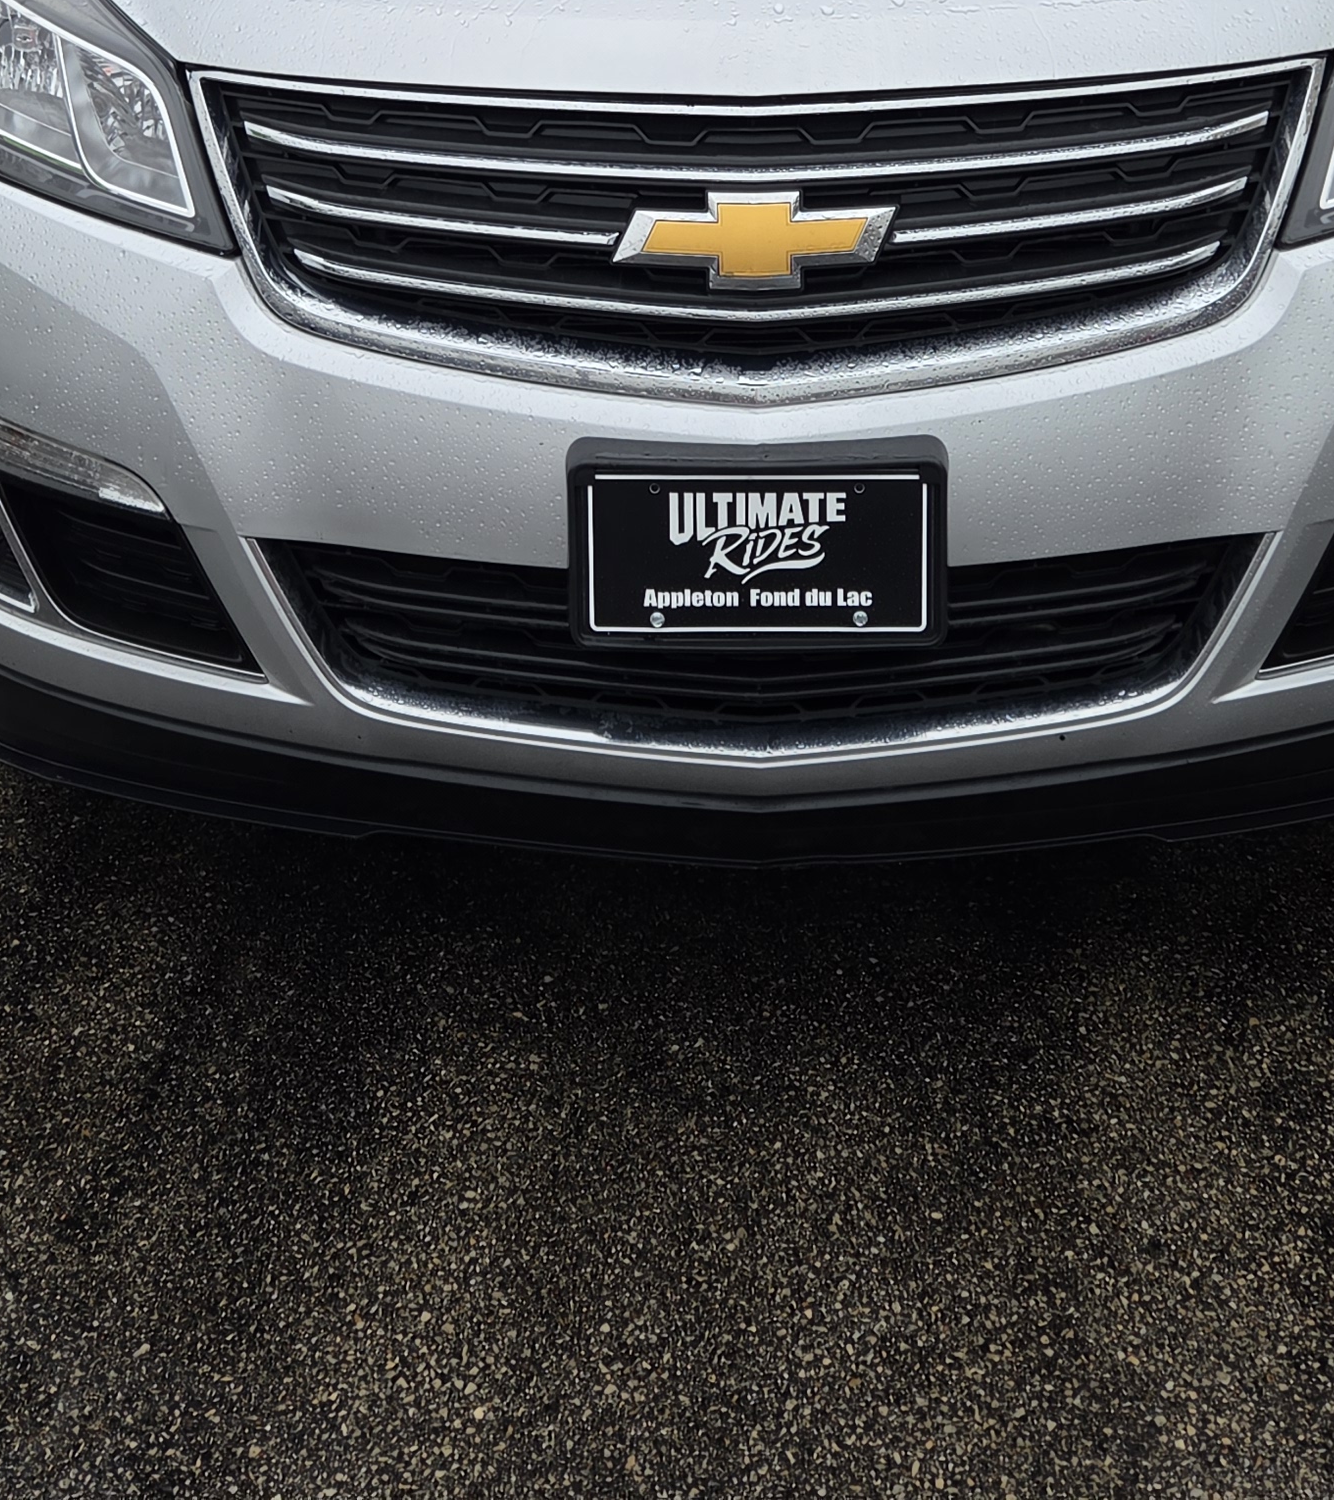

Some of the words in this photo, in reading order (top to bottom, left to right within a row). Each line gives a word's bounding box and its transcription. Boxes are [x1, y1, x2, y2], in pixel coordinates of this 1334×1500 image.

[668, 491, 847, 546] ULTIMATE
[643, 588, 740, 609] Appleton
[749, 588, 801, 607] Fond
[805, 588, 832, 607] du
[836, 588, 873, 607] Lac
